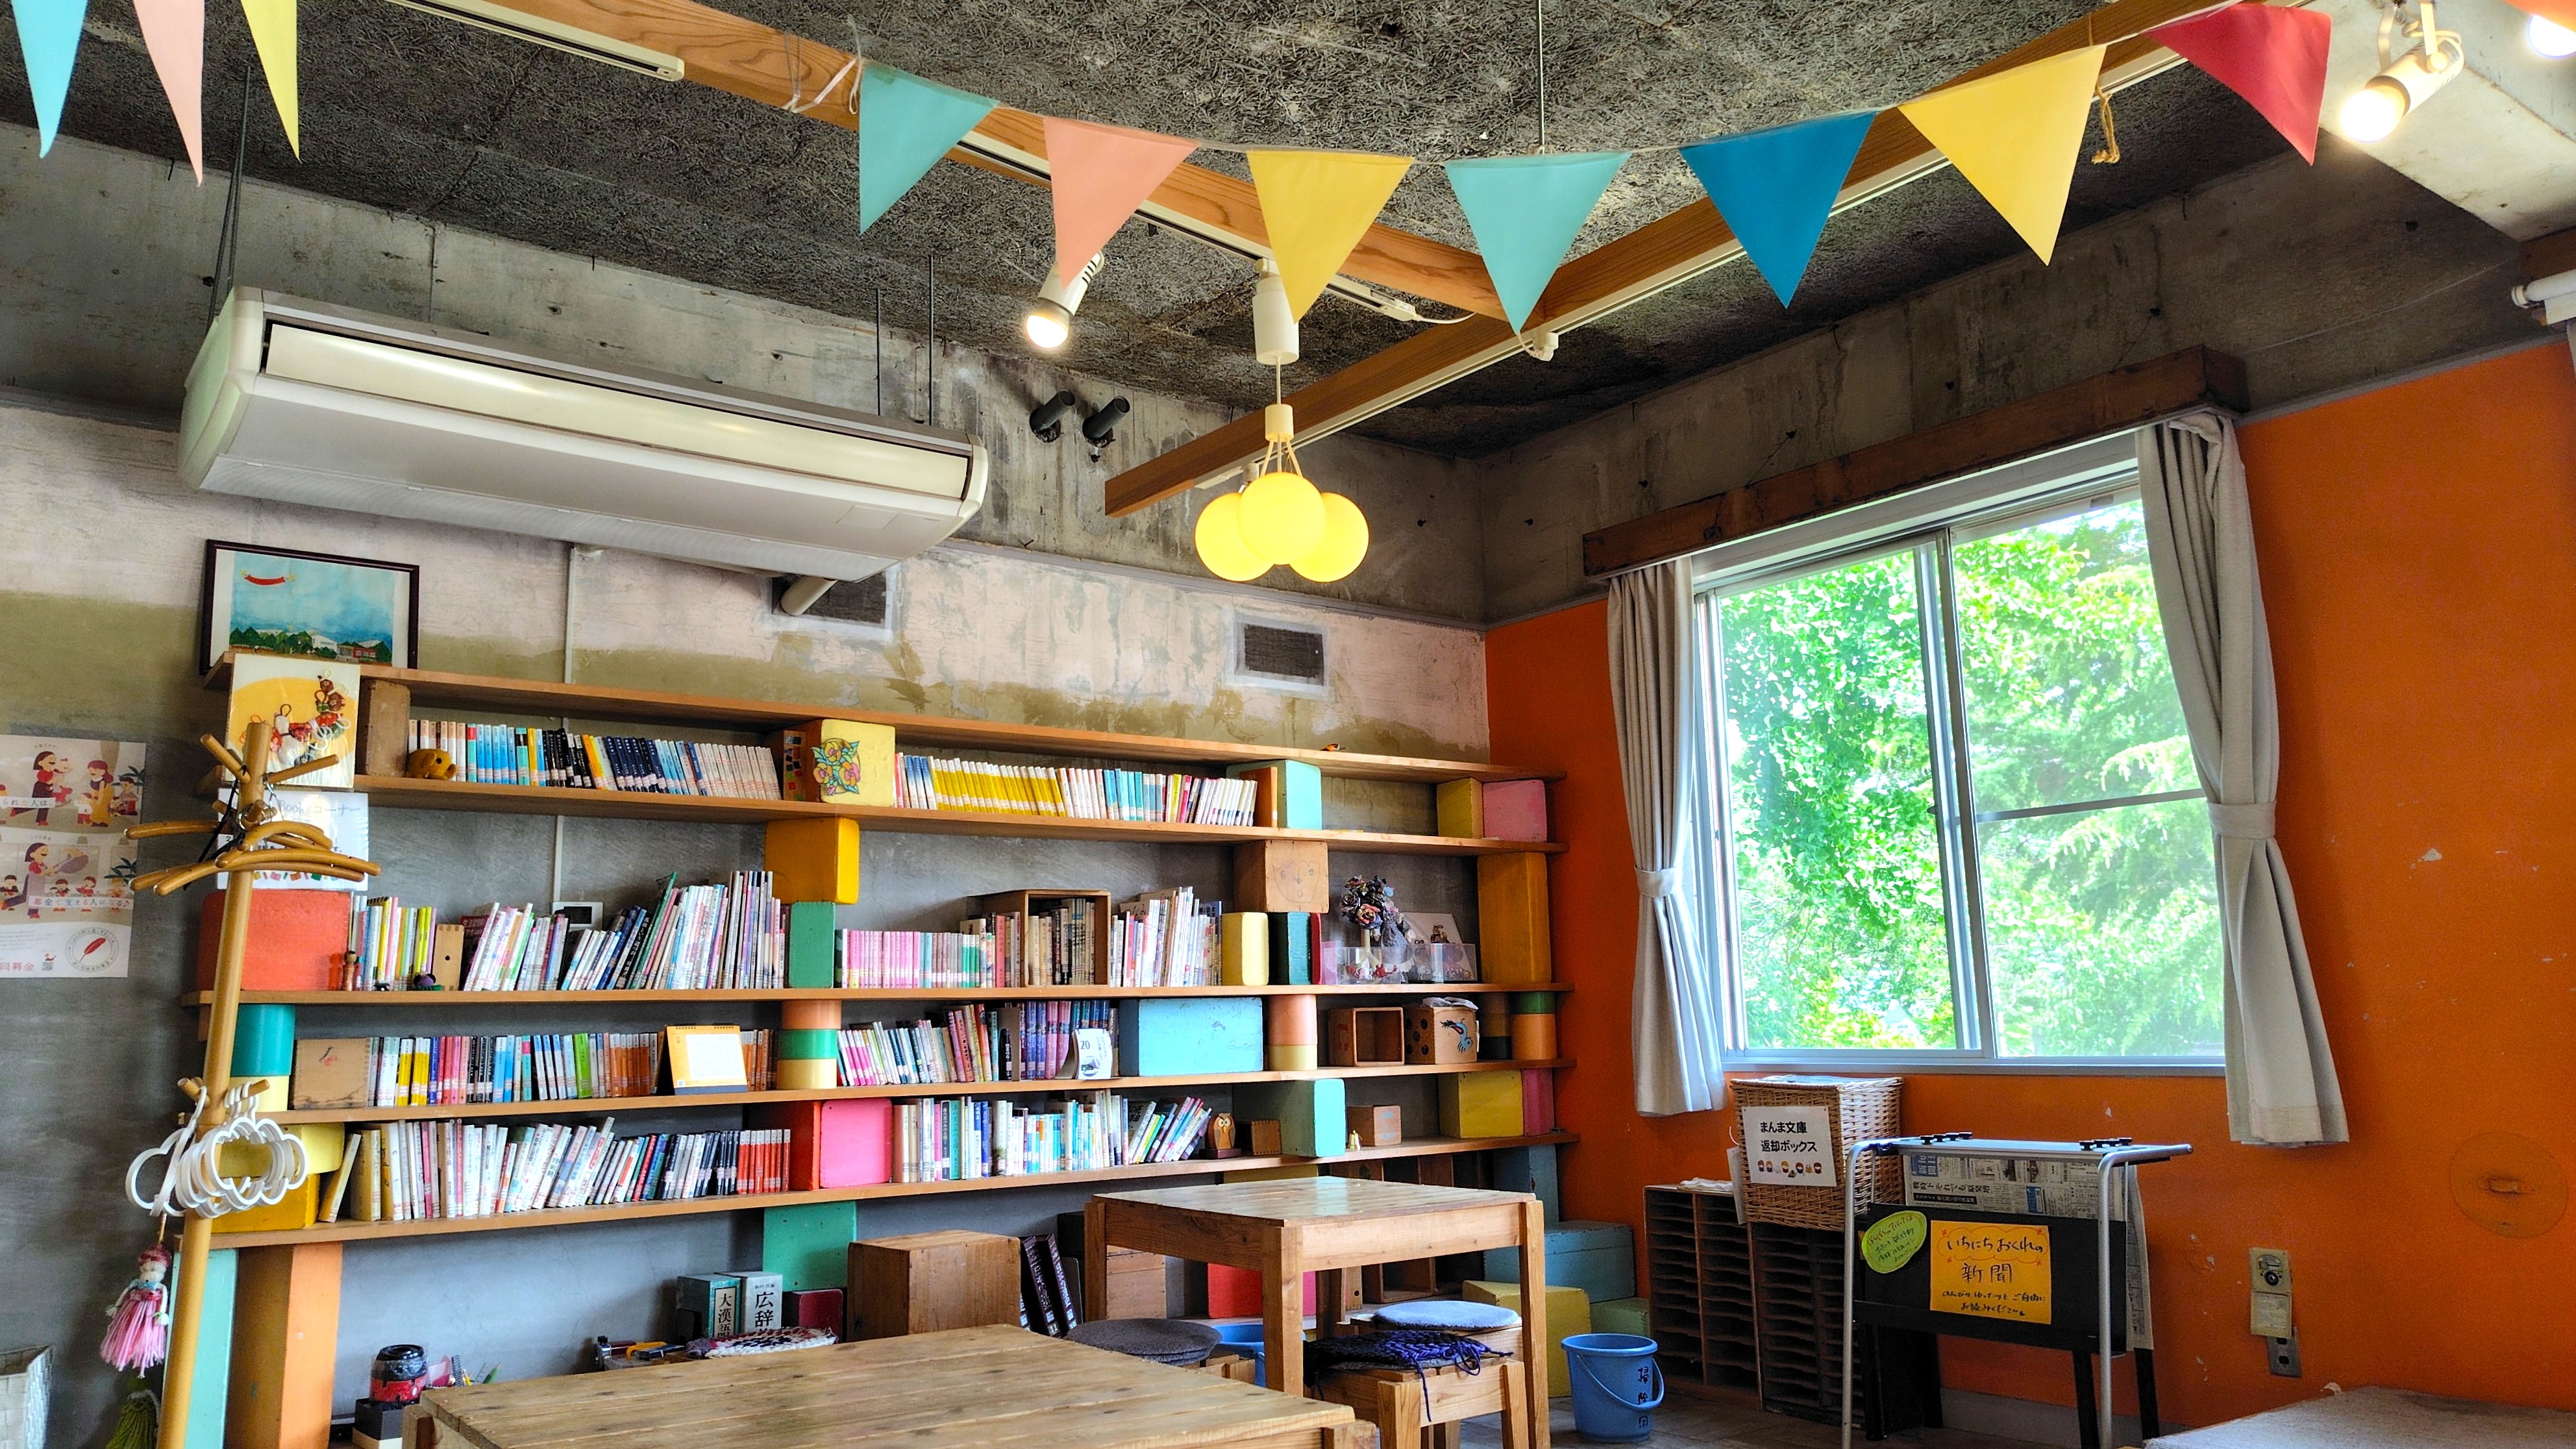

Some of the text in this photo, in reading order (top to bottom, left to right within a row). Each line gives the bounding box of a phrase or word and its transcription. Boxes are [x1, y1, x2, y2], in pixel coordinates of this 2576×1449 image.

[1080, 1040, 1091, 1050] 20
[1760, 1121, 1808, 1133] まんま文庫
[1761, 1140, 1818, 1153] 返却ボックス
[1961, 1263, 2012, 1283] 新聞
[754, 1291, 774, 1333] 広辞
